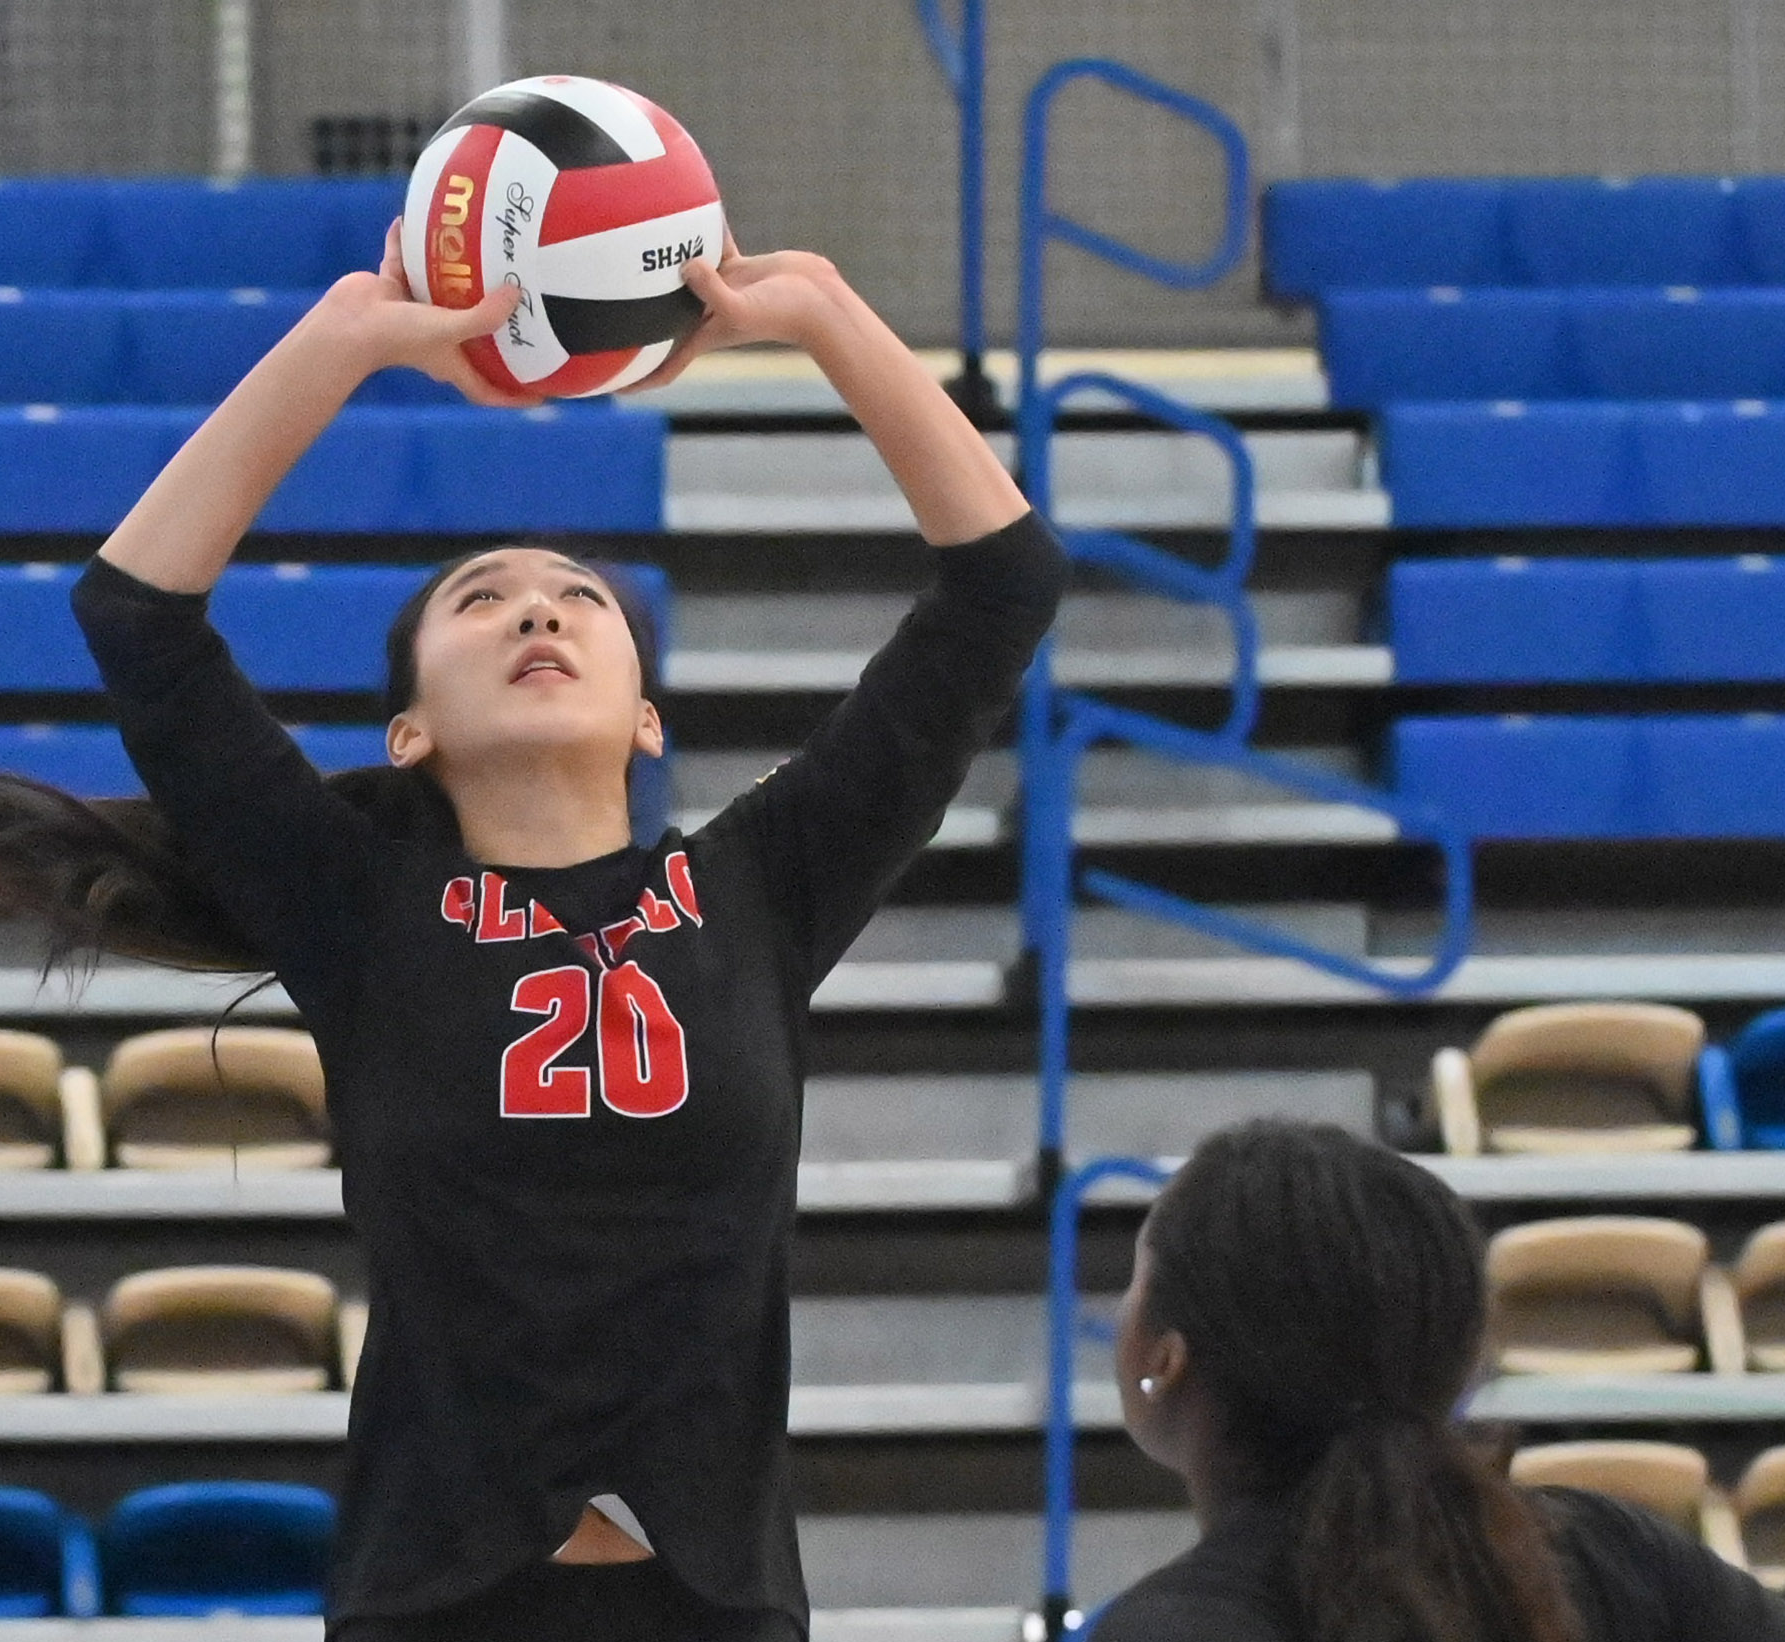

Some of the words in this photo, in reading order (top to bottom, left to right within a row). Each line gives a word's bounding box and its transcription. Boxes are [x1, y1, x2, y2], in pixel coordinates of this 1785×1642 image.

[438, 174, 474, 297] molt
[494, 181, 535, 263] Super
[641, 238, 694, 273] NFHS
[503, 271, 536, 349] Tuch
[500, 958, 689, 1119] 20
